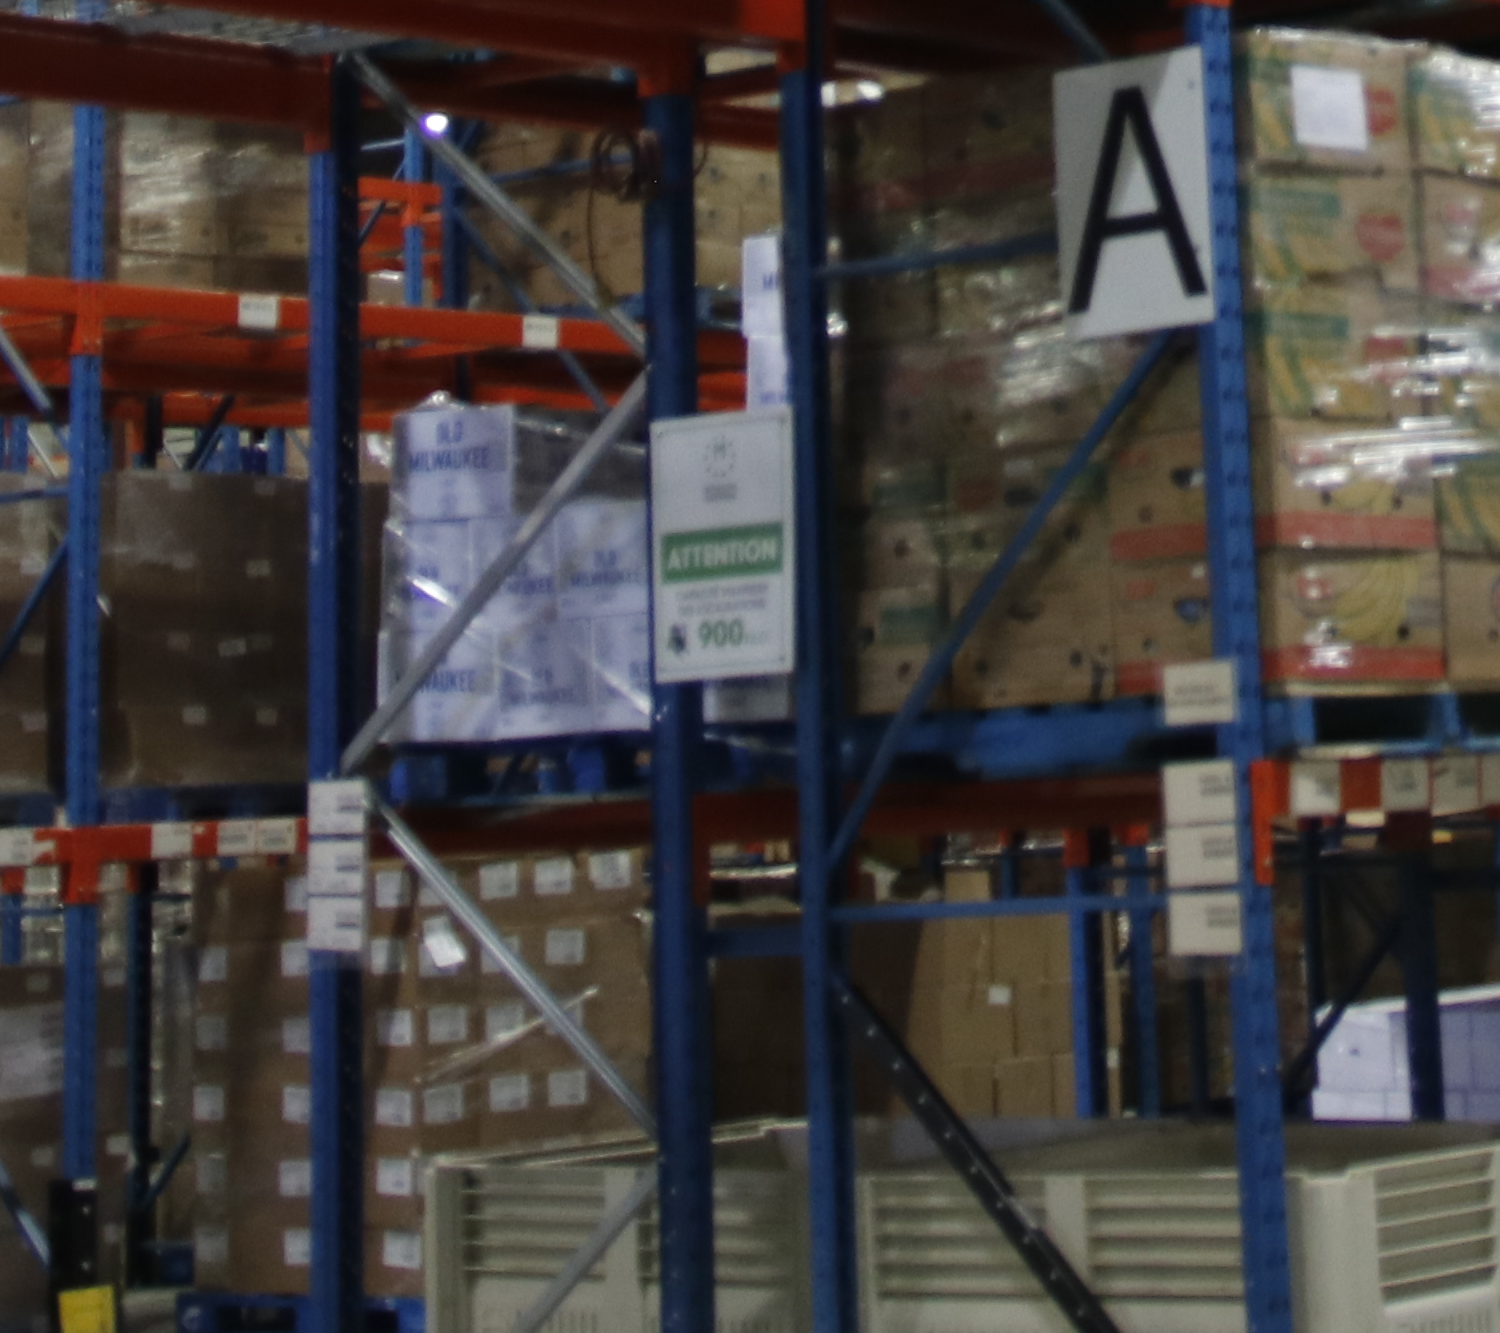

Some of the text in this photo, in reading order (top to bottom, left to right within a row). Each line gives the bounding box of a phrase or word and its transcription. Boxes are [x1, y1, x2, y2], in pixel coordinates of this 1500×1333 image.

[1069, 85, 1208, 315] A
[408, 445, 491, 473] MILWAUKEE
[666, 537, 777, 572] ATTENTION
[697, 616, 744, 649] 900
